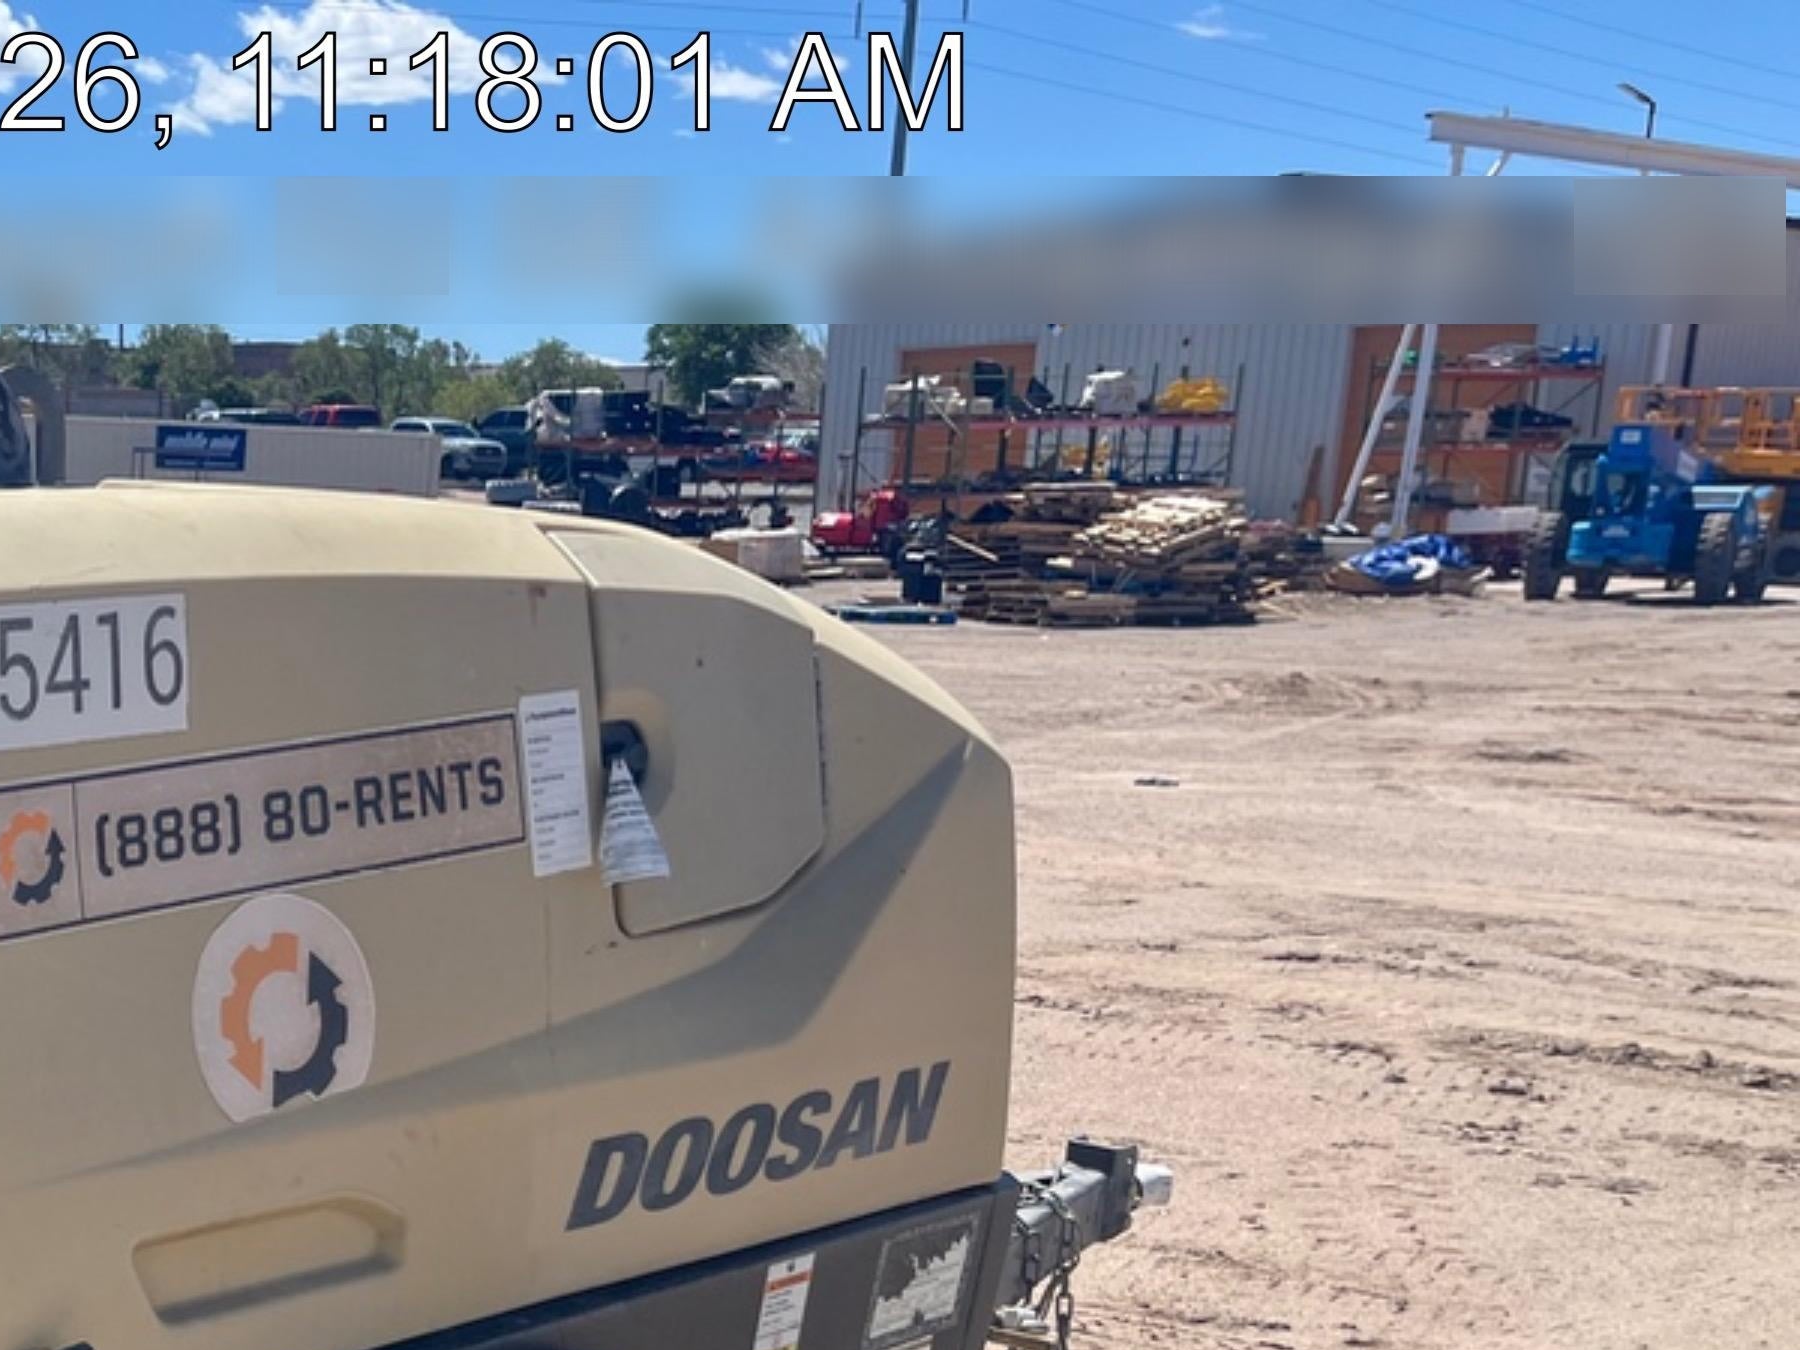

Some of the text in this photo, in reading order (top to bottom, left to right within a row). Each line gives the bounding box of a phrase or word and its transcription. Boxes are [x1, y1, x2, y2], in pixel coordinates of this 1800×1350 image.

[95, 757, 505, 877] (888) 80-RENTS
[564, 1059, 951, 1232] DOOSAN
